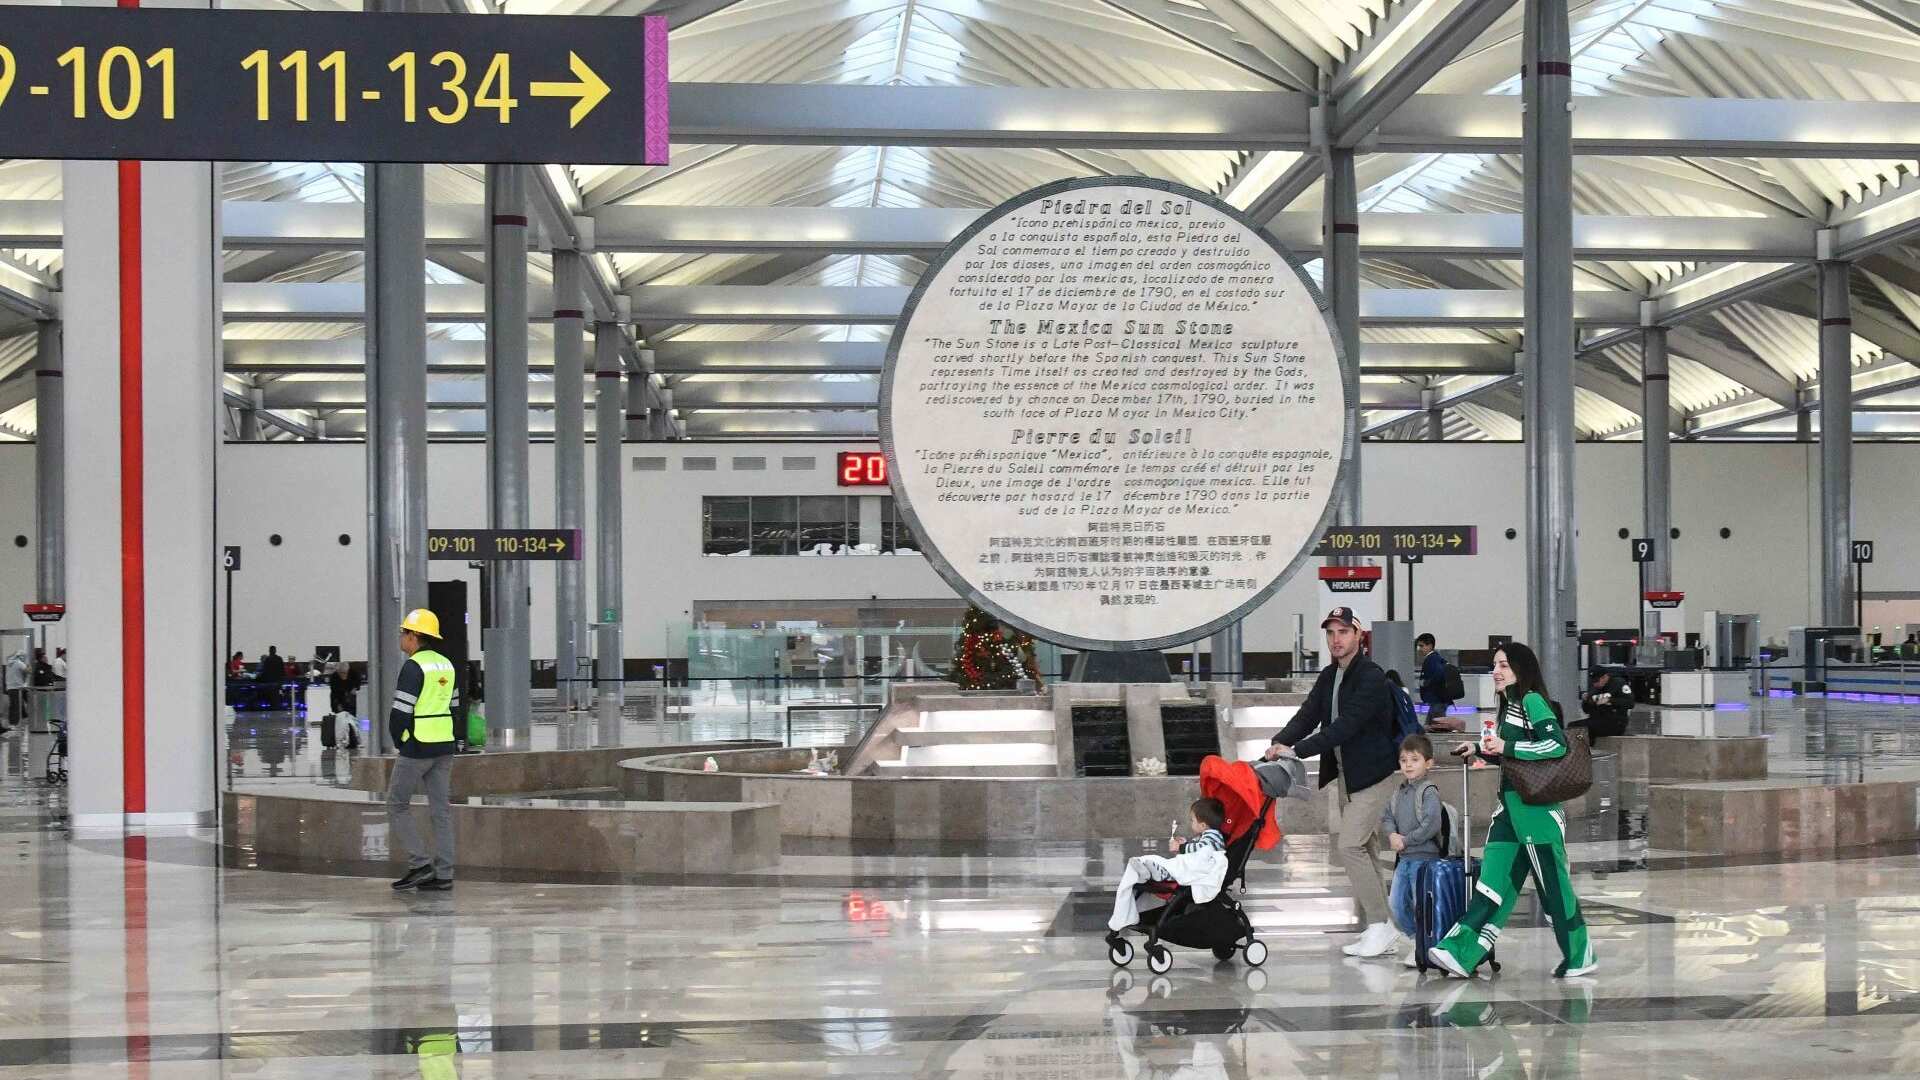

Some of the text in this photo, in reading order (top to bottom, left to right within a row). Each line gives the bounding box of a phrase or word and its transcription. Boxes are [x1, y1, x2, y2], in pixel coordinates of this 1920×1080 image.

[240, 49, 519, 124] 111-134
[1040, 199, 1192, 215] Piedra del Sol
[1188, 219, 1225, 230] previo
[1019, 232, 1078, 241] conquista
[1146, 233, 1172, 242] esta
[1176, 231, 1218, 242] Piedra
[1222, 232, 1240, 242] del
[977, 244, 1250, 257] Sol conmemora tiempo creado destruido
[964, 261, 985, 270] por
[989, 259, 1008, 269] los
[1060, 261, 1083, 269] una
[1087, 261, 1132, 271] imagen
[1136, 260, 1154, 269] del
[1159, 260, 1191, 269] orden
[957, 272, 1031, 283] considerado
[1034, 275, 1055, 284] por
[1059, 273, 1077, 283] los
[1142, 273, 1207, 283] localizado
[1210, 274, 1224, 283] de
[1227, 276, 1274, 284] manera
[949, 286, 997, 296] fortuita
[1001, 286, 1012, 296] el
[1017, 285, 1034, 296] 17
[1037, 287, 1051, 296] de
[1054, 286, 1116, 296] diciembre
[1121, 286, 1136, 297] de
[1199, 287, 1210, 297] el
[1215, 286, 1260, 297] costado
[978, 301, 993, 310] de
[996, 300, 1010, 310] la
[1015, 299, 1053, 310] Plaza
[1057, 299, 1098, 312] Mayor
[1102, 300, 1117, 310] de
[1121, 301, 1135, 310] la
[1139, 300, 1182, 311] Ciudad
[1186, 300, 1200, 310] de
[990, 319, 1233, 334] The Mexica Sun Stone
[955, 338, 980, 348] Sun
[984, 337, 1019, 348] Stone
[1052, 338, 1079, 349] Late
[1083, 338, 1180, 349] Post-Classical
[1188, 338, 1232, 349] Mexica
[1240, 339, 1298, 350] sculpture
[933, 353, 974, 362] carved
[979, 352, 1024, 364] shortly
[1029, 352, 1066, 362] before
[1071, 352, 1089, 362] the
[1095, 351, 1146, 364] Spanish
[1212, 351, 1238, 362] This
[1243, 352, 1267, 362] Sun
[1272, 352, 1305, 363] Stone
[930, 368, 994, 377] represents
[1000, 365, 1032, 376] Time
[1034, 366, 1069, 376] itself
[1091, 367, 1139, 376] created
[1143, 366, 1166, 376] and
[1170, 367, 1228, 378] destroyed
[1233, 367, 1248, 378] by
[1253, 367, 1271, 376] the
[919, 380, 987, 392] portraying
[991, 381, 1010, 390] the
[1013, 382, 1059, 390] essence
[1079, 381, 1097, 389] the
[1100, 379, 1146, 390] Mexica
[1150, 380, 1227, 392] cosmological
[1293, 382, 1315, 390] was
[925, 394, 1003, 404] rediscovered
[1007, 394, 1022, 406] by
[1027, 394, 1069, 404] chance
[1090, 393, 1152, 404] December
[1233, 394, 1274, 404] buried
[1297, 394, 1315, 403] the
[983, 408, 1014, 417] south
[1020, 408, 1045, 417] face
[1063, 407, 1102, 417] Plaza
[1107, 407, 1150, 419] Mayor
[1172, 407, 1216, 418] Mexico
[1011, 428, 1192, 444] Pierre du Soleil
[844, 456, 885, 482] 20
[942, 462, 984, 473] Pierre
[987, 462, 1002, 473] du
[1007, 462, 1043, 473] Soleil
[1141, 464, 1175, 472] temps
[1271, 464, 1292, 473] par
[1297, 462, 1314, 472] les
[980, 479, 1002, 487] une
[1006, 477, 1043, 489] image
[1066, 477, 1110, 487] l'ordre
[1123, 478, 1205, 488] cosmogonique
[1261, 475, 1290, 485] Elle
[1294, 475, 1310, 485] fut
[1004, 493, 1026, 502] par
[1031, 490, 1075, 501] hasard
[1095, 490, 1111, 501] 17
[1184, 489, 1217, 500] 1790
[1220, 491, 1250, 500] dans
[1272, 490, 1309, 501] partie
[1018, 506, 1039, 515] sud
[1080, 504, 1118, 514] Plaza
[1122, 503, 1163, 516] Mayor
[495, 537, 547, 553] 110-134
[1329, 533, 1445, 549] 109-101 110-134
[1638, 542, 1648, 558] 9
[1853, 543, 1871, 559] 10
[225, 550, 234, 567] 6
[1331, 581, 1371, 591] HIDRANTE
